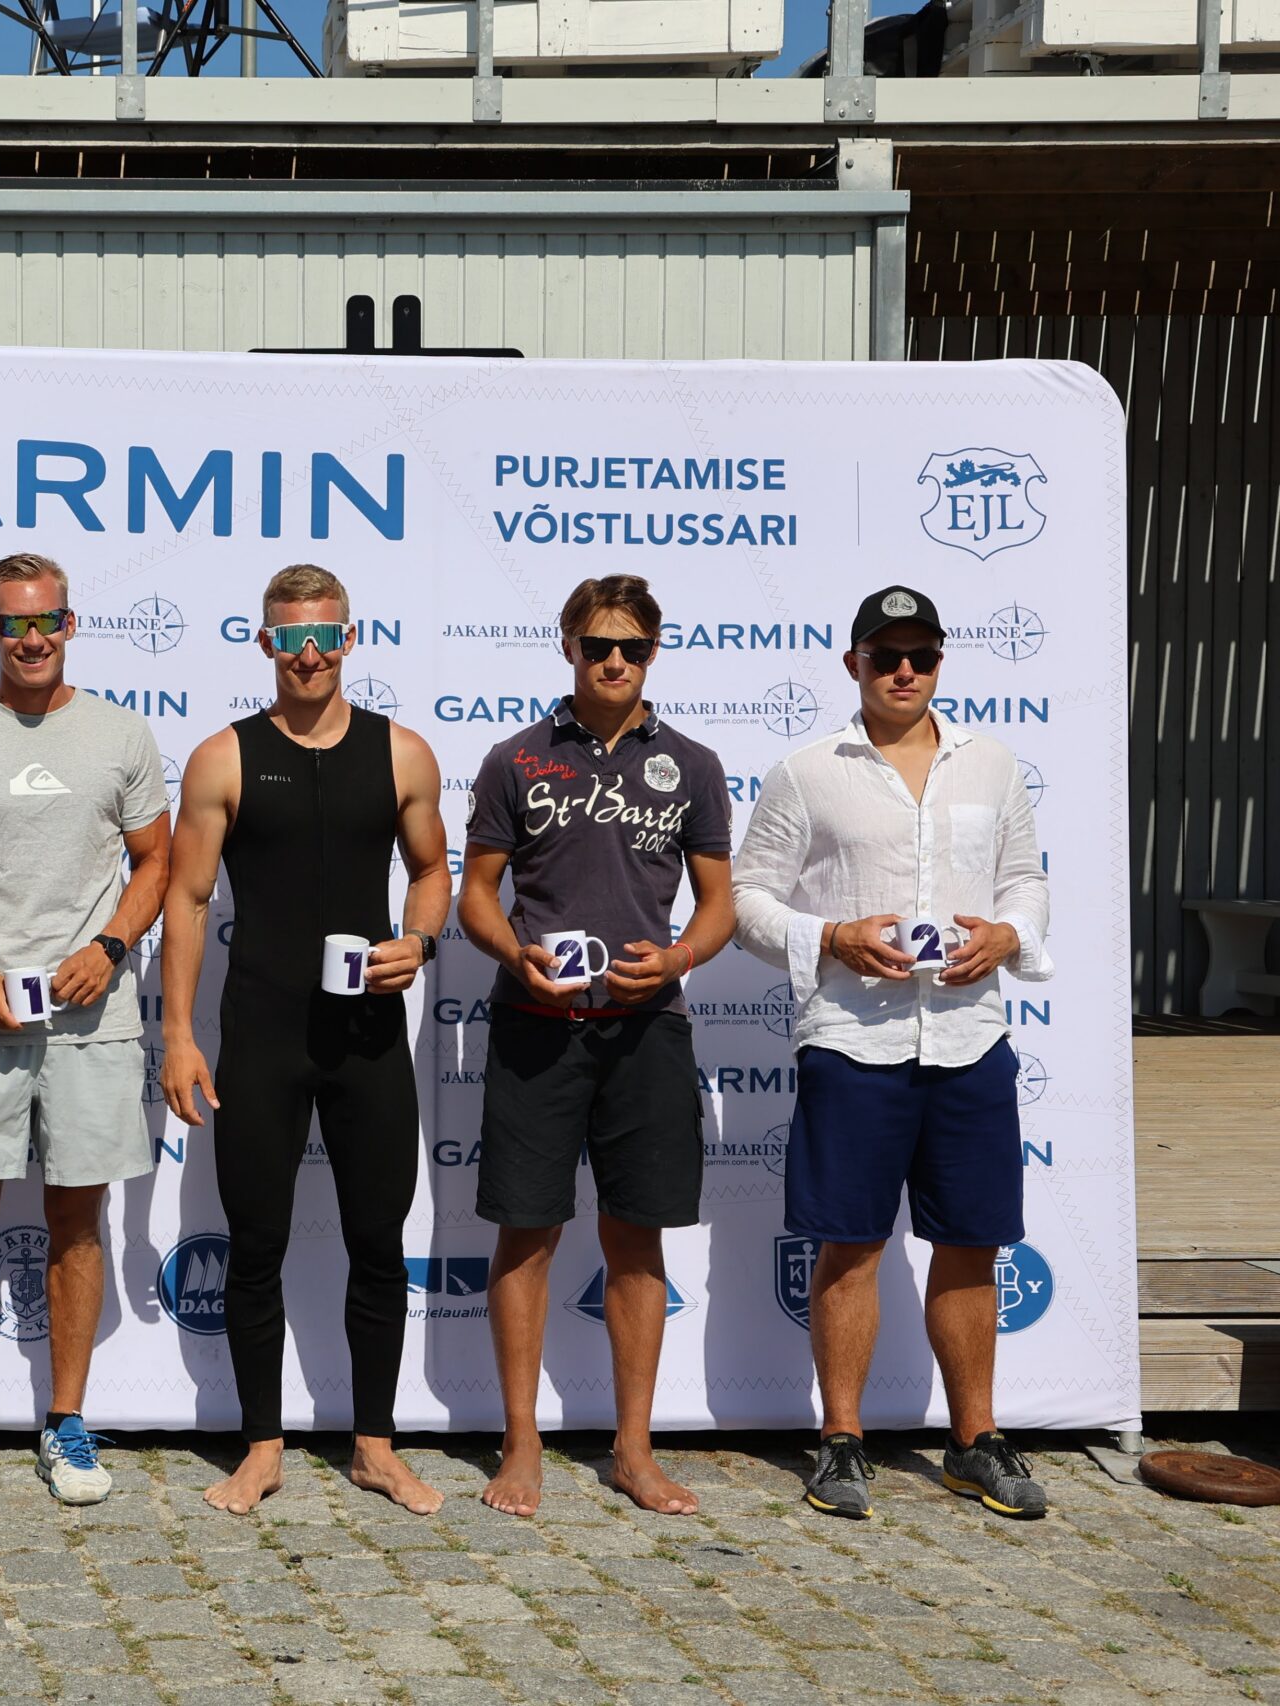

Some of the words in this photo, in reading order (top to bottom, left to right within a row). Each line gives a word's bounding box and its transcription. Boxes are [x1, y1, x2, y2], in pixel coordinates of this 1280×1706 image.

[495, 455, 787, 491] PURJETAMISE
[947, 493, 1025, 541] EJL
[494, 503, 798, 547] VÕISTLUSSARI
[89, 616, 161, 631] MARINE
[73, 631, 125, 640] armin.com.ee
[443, 624, 508, 638] JAKARI
[658, 623, 833, 650] GARMIN
[946, 627, 1021, 639] MARINE
[495, 641, 550, 649] garmin.com.ee
[82, 688, 188, 717] MIN
[229, 697, 272, 709] JAKA
[434, 695, 561, 723] GARM
[654, 702, 718, 714] JAKARI
[723, 702, 795, 715] MARINE
[931, 697, 1049, 724] RMIN
[704, 717, 760, 726] garmin.com.ee
[910, 923, 944, 962] 2
[554, 938, 586, 979] 2
[343, 951, 364, 989] 1
[21, 975, 45, 1015] 1
[723, 1003, 795, 1016] MARINE
[704, 1019, 760, 1027] garmin.com.ee
[441, 1070, 486, 1084] JAKA
[704, 1159, 759, 1167] garmin.com.ee
[408, 1306, 489, 1320] urjelaualiit
